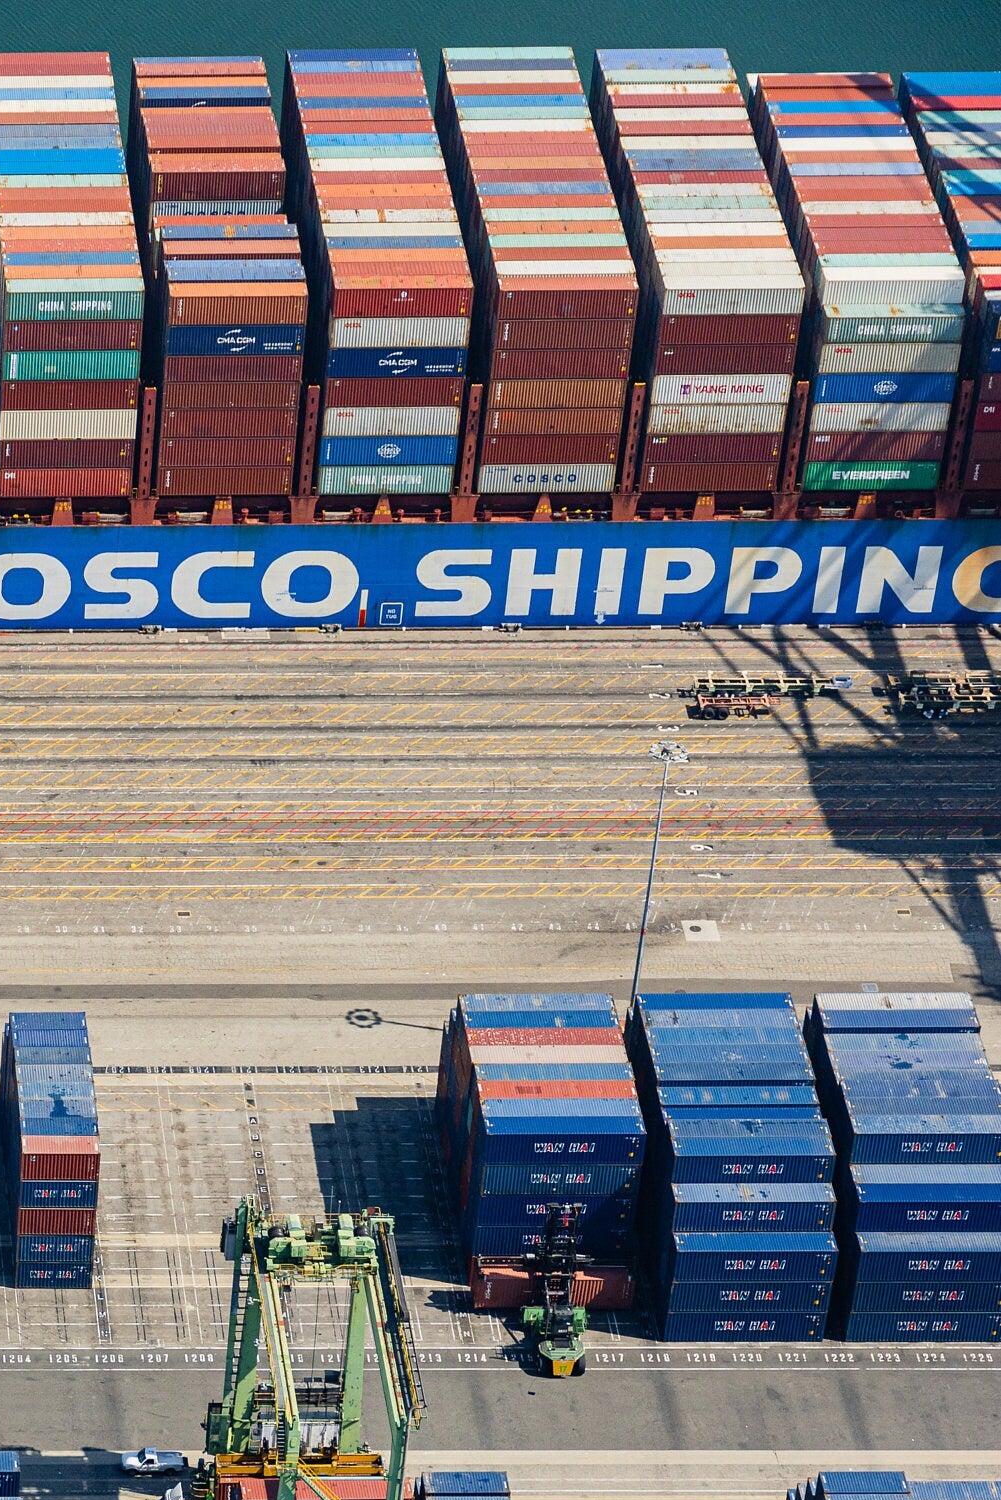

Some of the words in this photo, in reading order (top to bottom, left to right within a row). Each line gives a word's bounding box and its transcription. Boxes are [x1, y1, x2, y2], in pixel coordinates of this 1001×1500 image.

[38, 300, 64, 311] CHINA
[71, 300, 112, 311] SHIPPING
[857, 323, 885, 335] CHINA
[890, 323, 932, 335] SHIPPING
[693, 384, 727, 394] YANG
[730, 384, 765, 394] MING
[350, 474, 376, 485] CHINA
[381, 474, 422, 485] SHIPPING
[831, 469, 911, 480] EVERGREEN
[535, 1143, 564, 1152] WAN
[569, 1143, 595, 1152] HAI
[907, 1210, 938, 1220] WAN
[942, 1210, 969, 1220] HAI
[725, 1260, 755, 1270] WAN
[759, 1260, 786, 1270] HAI
[2, 1353, 31, 1363] 1204
[49, 1353, 78, 1363] 1205
[94, 1353, 124, 1363] 1206
[457, 1353, 487, 1363] 1214
[595, 1353, 624, 1363] 1217
[824, 1353, 854, 1363] 1222
[963, 1353, 993, 1363] 1225
[559, 1365, 567, 1373] 17
